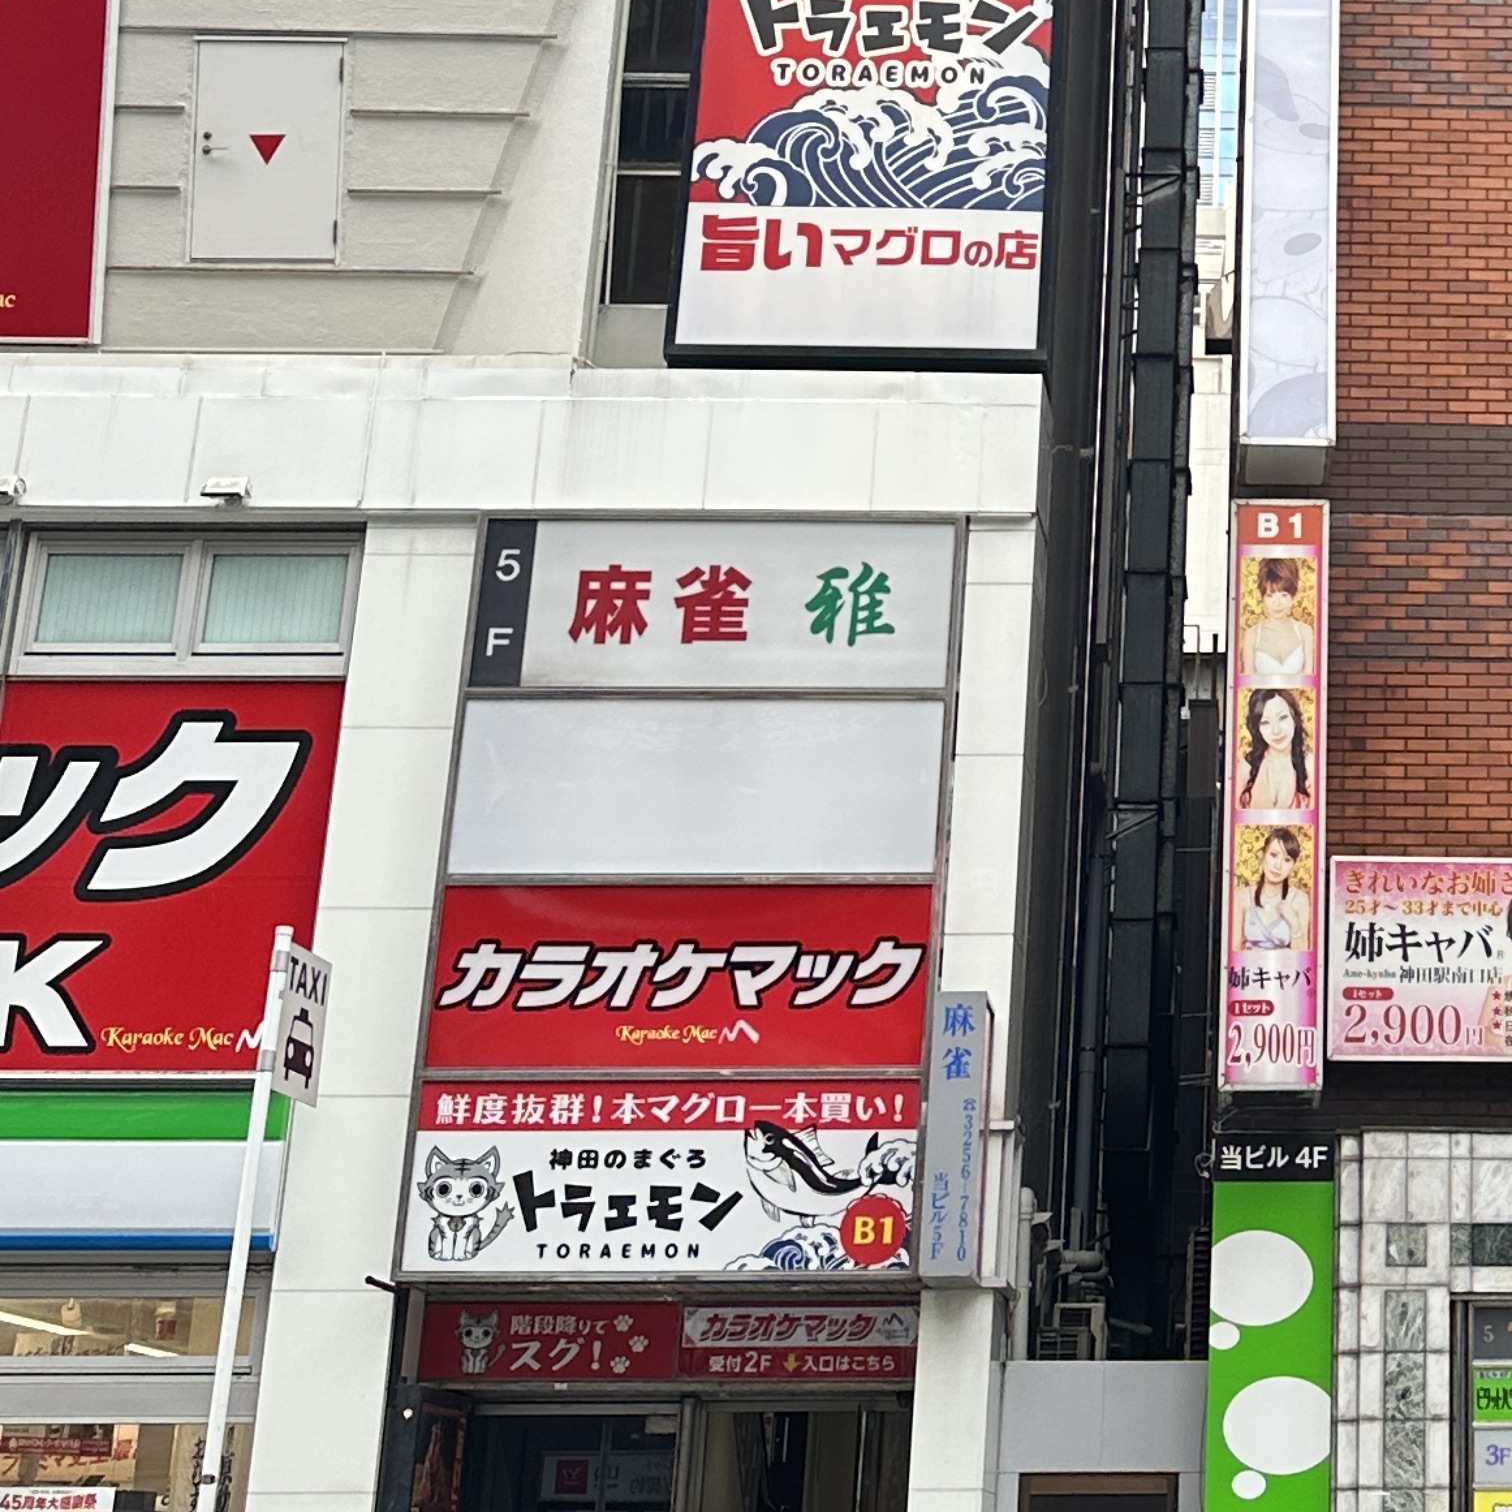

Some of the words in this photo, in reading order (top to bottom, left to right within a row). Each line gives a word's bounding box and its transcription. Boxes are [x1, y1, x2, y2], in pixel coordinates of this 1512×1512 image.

[776, 62, 986, 85] TORAEMON
[701, 214, 1039, 271] 旨いマグロの店
[1257, 512, 1303, 539] B1
[567, 563, 753, 645] 麻雀
[802, 560, 896, 648] 雅
[1344, 921, 1495, 964] 姉キャバ
[288, 955, 328, 1007] TAXI
[433, 937, 929, 1013] カラオケマック
[1229, 966, 1312, 991] 姉キャバ
[100, 1026, 185, 1054] Karaoke
[188, 1026, 235, 1052] Mac
[616, 1025, 681, 1046] Karaoke
[682, 1024, 718, 1044] Mac
[942, 1003, 976, 1081] 麻雀
[1343, 1003, 1484, 1047] 2,900円
[1227, 1022, 1317, 1068] 2,900円
[548, 1146, 708, 1171] 神田のまぐろ
[1219, 1145, 1289, 1171] 当ビル
[1295, 1146, 1329, 1169] 4F
[511, 1168, 743, 1233] トラエモン
[928, 1171, 951, 1261] 当ビル5F
[851, 1210, 895, 1246] B1
[536, 1242, 701, 1260] TORAEMON
[509, 1314, 607, 1337] 階段降りて
[698, 1311, 877, 1344] カラオケマック
[507, 1337, 603, 1372] スグ!
[707, 1351, 772, 1374] 受付2F
[802, 1353, 897, 1373] 入口はこちら
[1485, 1444, 1512, 1466] 3F
